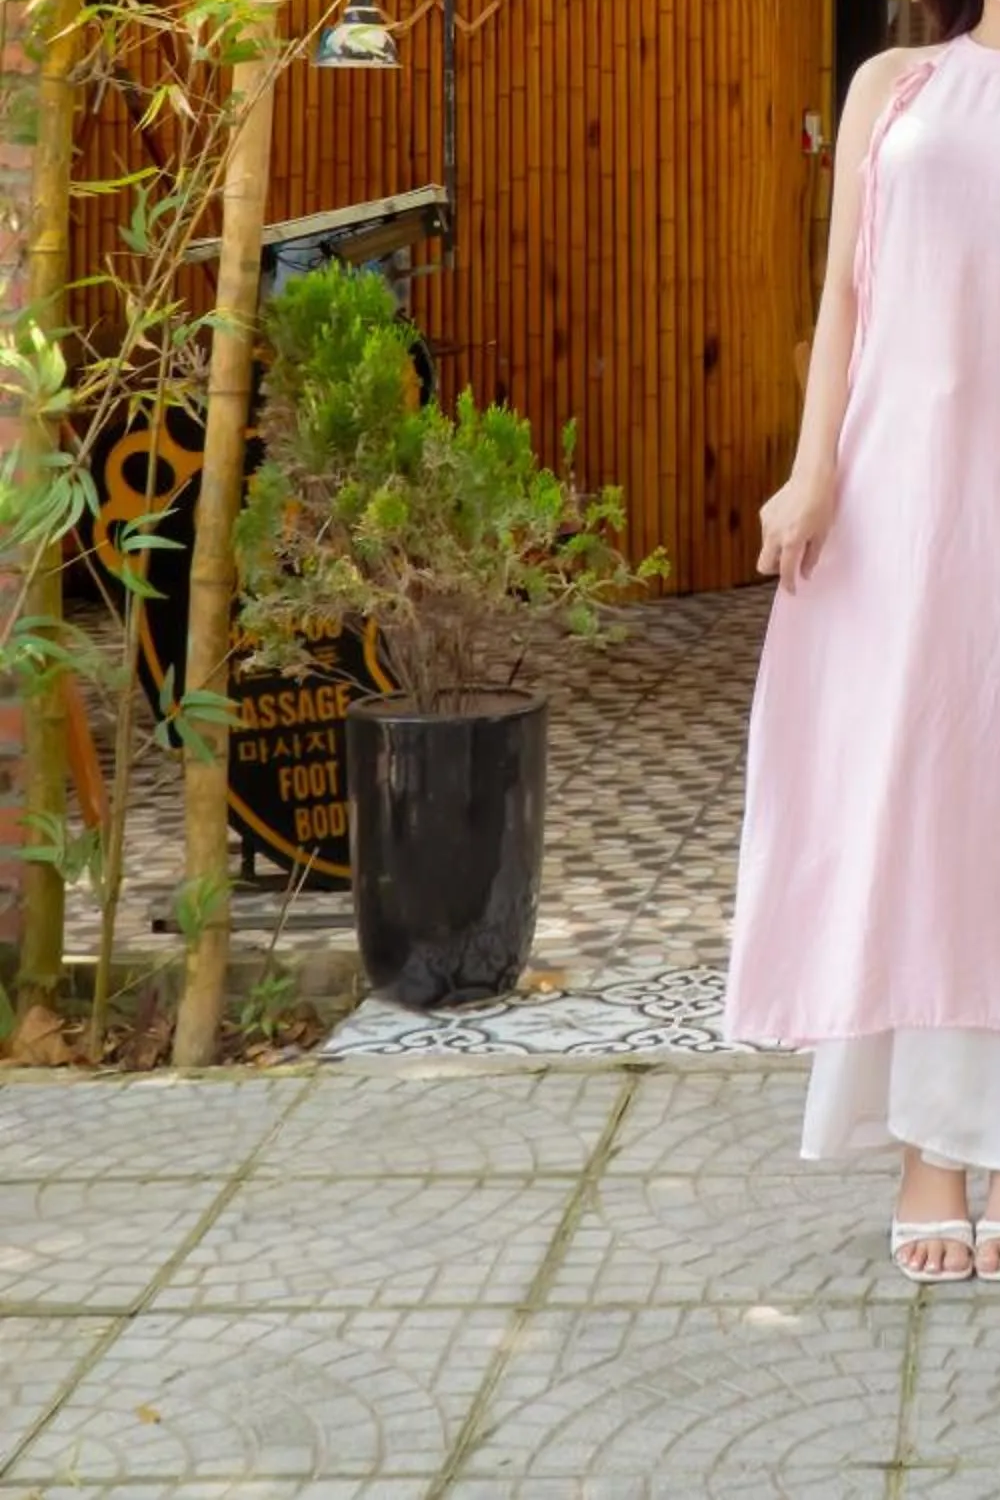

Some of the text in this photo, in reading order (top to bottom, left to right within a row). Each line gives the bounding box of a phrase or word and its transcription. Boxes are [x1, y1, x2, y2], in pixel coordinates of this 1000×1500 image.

[226, 683, 350, 733] ASSAGE
[238, 727, 337, 764] 마사지
[278, 761, 339, 802] FOOT
[294, 802, 349, 842] BOD
